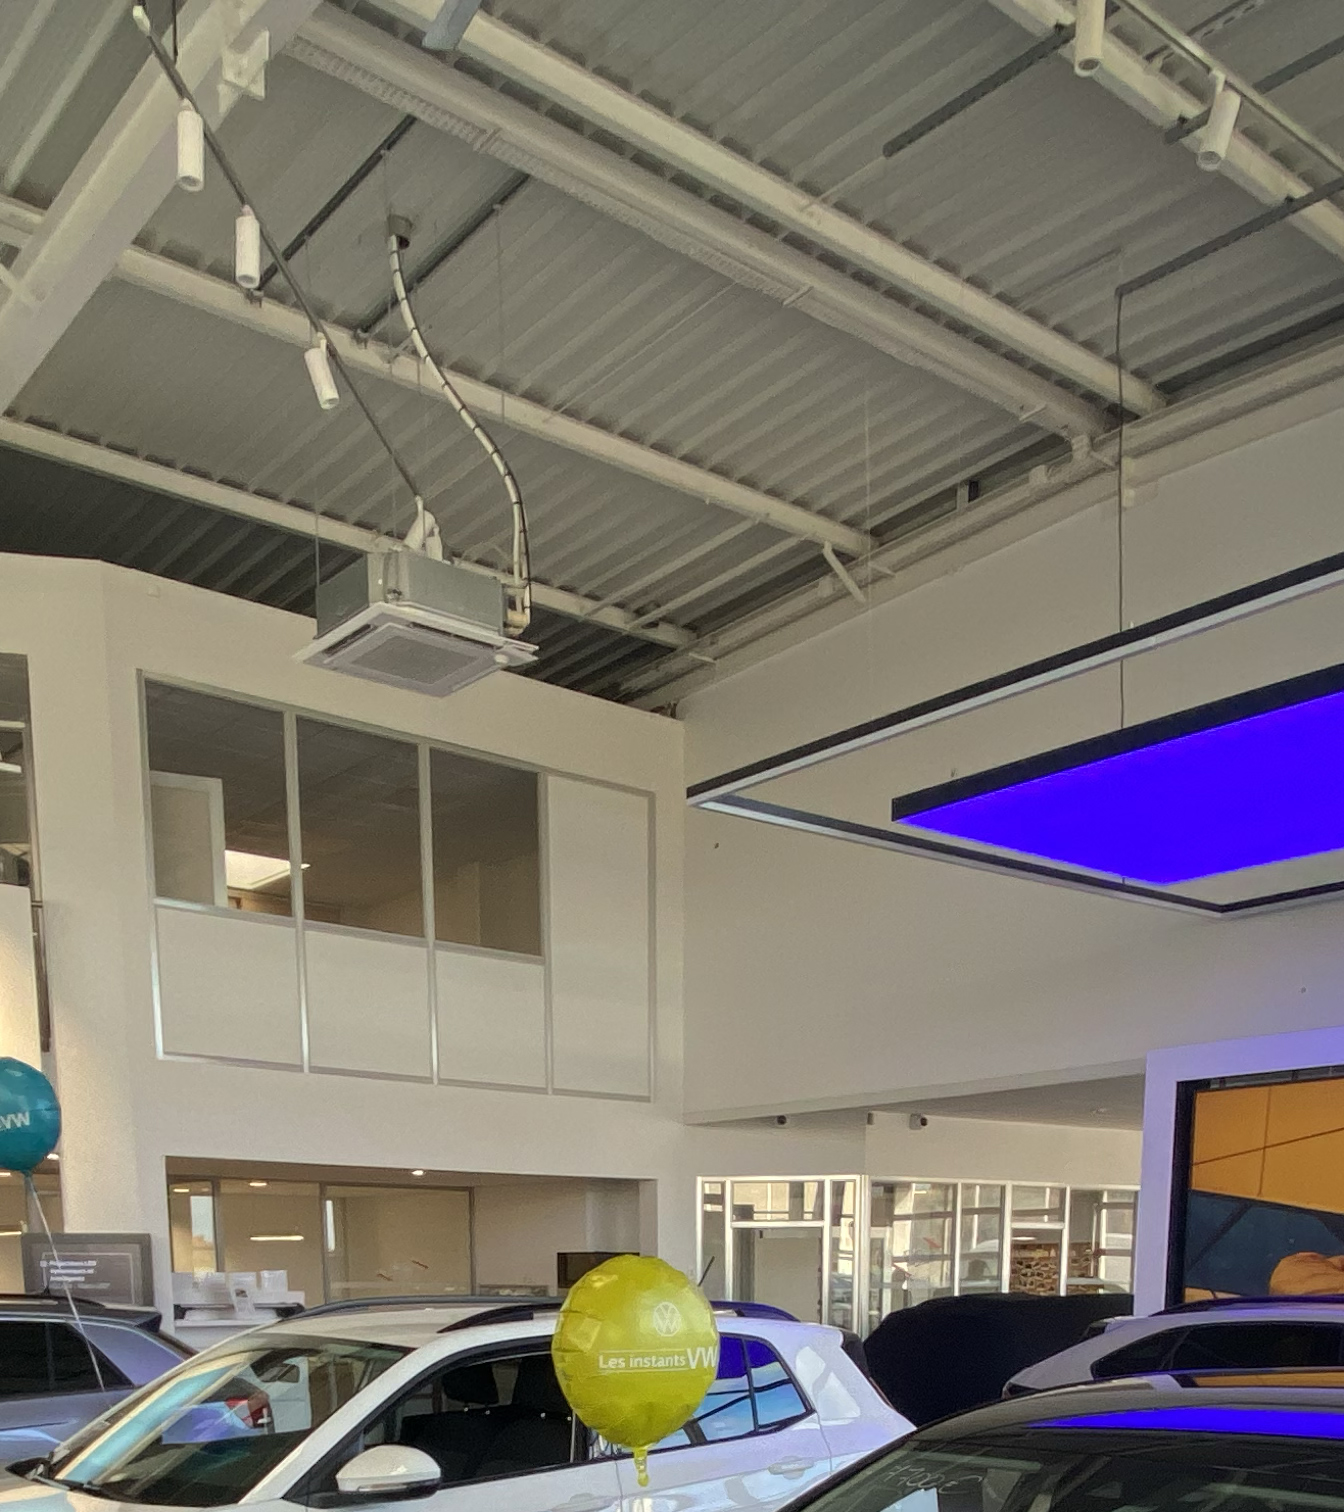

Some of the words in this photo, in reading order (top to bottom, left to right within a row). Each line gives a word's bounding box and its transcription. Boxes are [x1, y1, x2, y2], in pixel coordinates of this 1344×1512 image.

[0, 1111, 30, 1129] VW
[598, 1354, 625, 1369] Les
[629, 1353, 686, 1368] instants
[686, 1345, 719, 1370] VW
